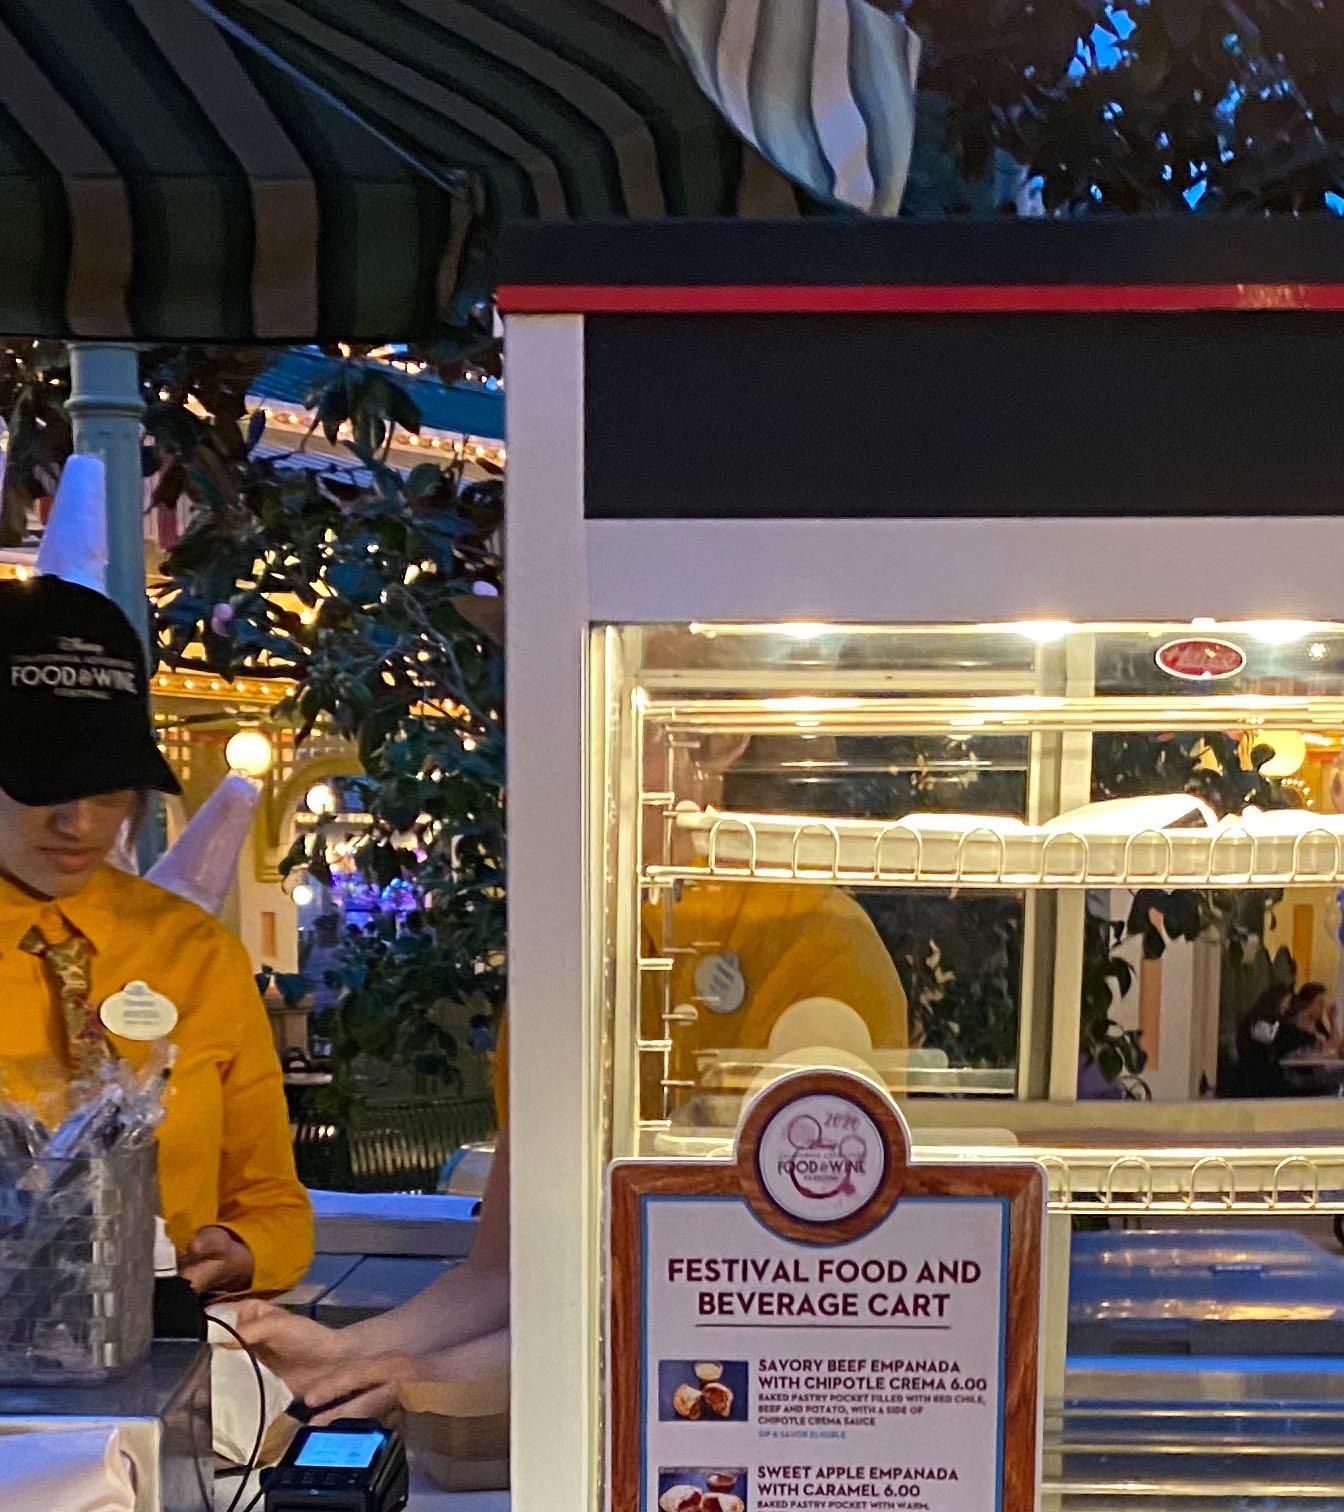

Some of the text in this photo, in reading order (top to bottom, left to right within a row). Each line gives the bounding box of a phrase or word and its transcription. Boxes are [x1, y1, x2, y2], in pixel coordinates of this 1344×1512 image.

[10, 664, 77, 687] FOOD
[777, 1160, 818, 1175] FOOD
[667, 1258, 982, 1284] FESTIVAL FOOD AND
[697, 1291, 952, 1317] BEVERAGE CART
[758, 1358, 961, 1373] SAVORY BEEF EMPANADA
[758, 1376, 988, 1391] WITH CHIPOTLE CREMA 6.00
[758, 1393, 789, 1402] BAKED
[791, 1393, 827, 1402] PASTRY
[829, 1394, 869, 1403] POCKET
[871, 1394, 903, 1403] FILLED
[906, 1394, 931, 1403] WITH
[933, 1395, 952, 1403] RED
[758, 1404, 923, 1414] BEEF AND POTATO, WITH A SIDE OF
[758, 1416, 876, 1426] CHIPOTLE CREMA SAUCE
[757, 1465, 959, 1481] SWEET APPLE EMPANADA
[757, 1483, 921, 1497] WITH CARAMEL 6.00
[757, 1500, 788, 1508] BAKED
[790, 1501, 826, 1509] PASTRY
[828, 1501, 867, 1509] POCKET
[869, 1501, 895, 1509] WITH
